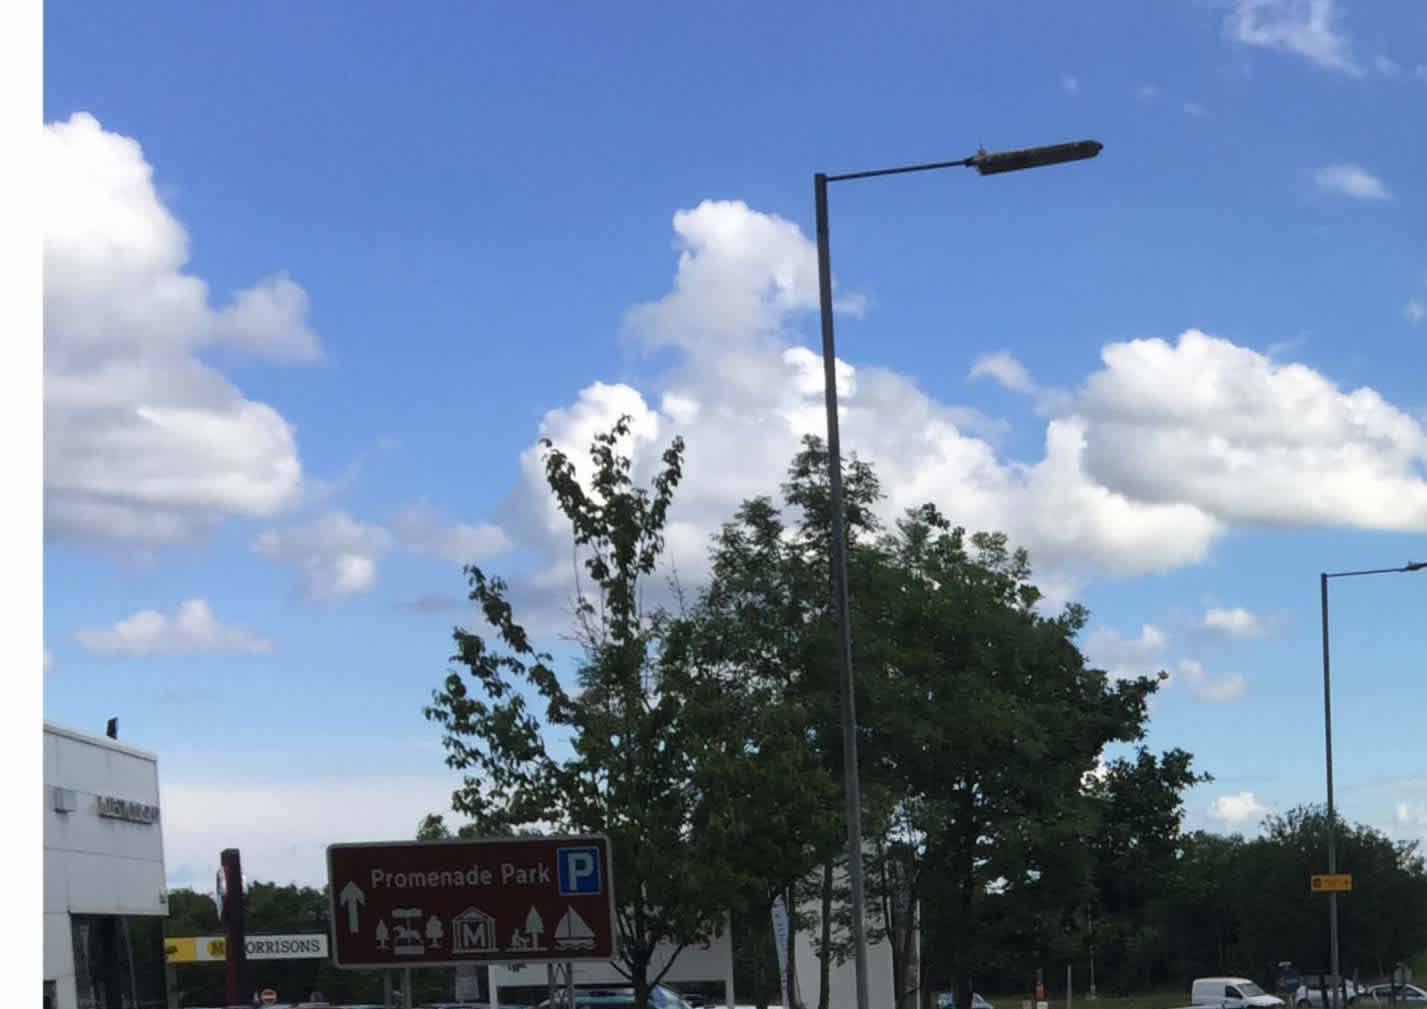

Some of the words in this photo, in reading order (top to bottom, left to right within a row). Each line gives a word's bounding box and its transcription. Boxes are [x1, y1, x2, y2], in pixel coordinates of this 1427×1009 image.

[371, 865, 493, 888] Promenade
[501, 862, 551, 885] Park
[567, 852, 594, 891] P
[246, 938, 321, 954] ORRISONS
